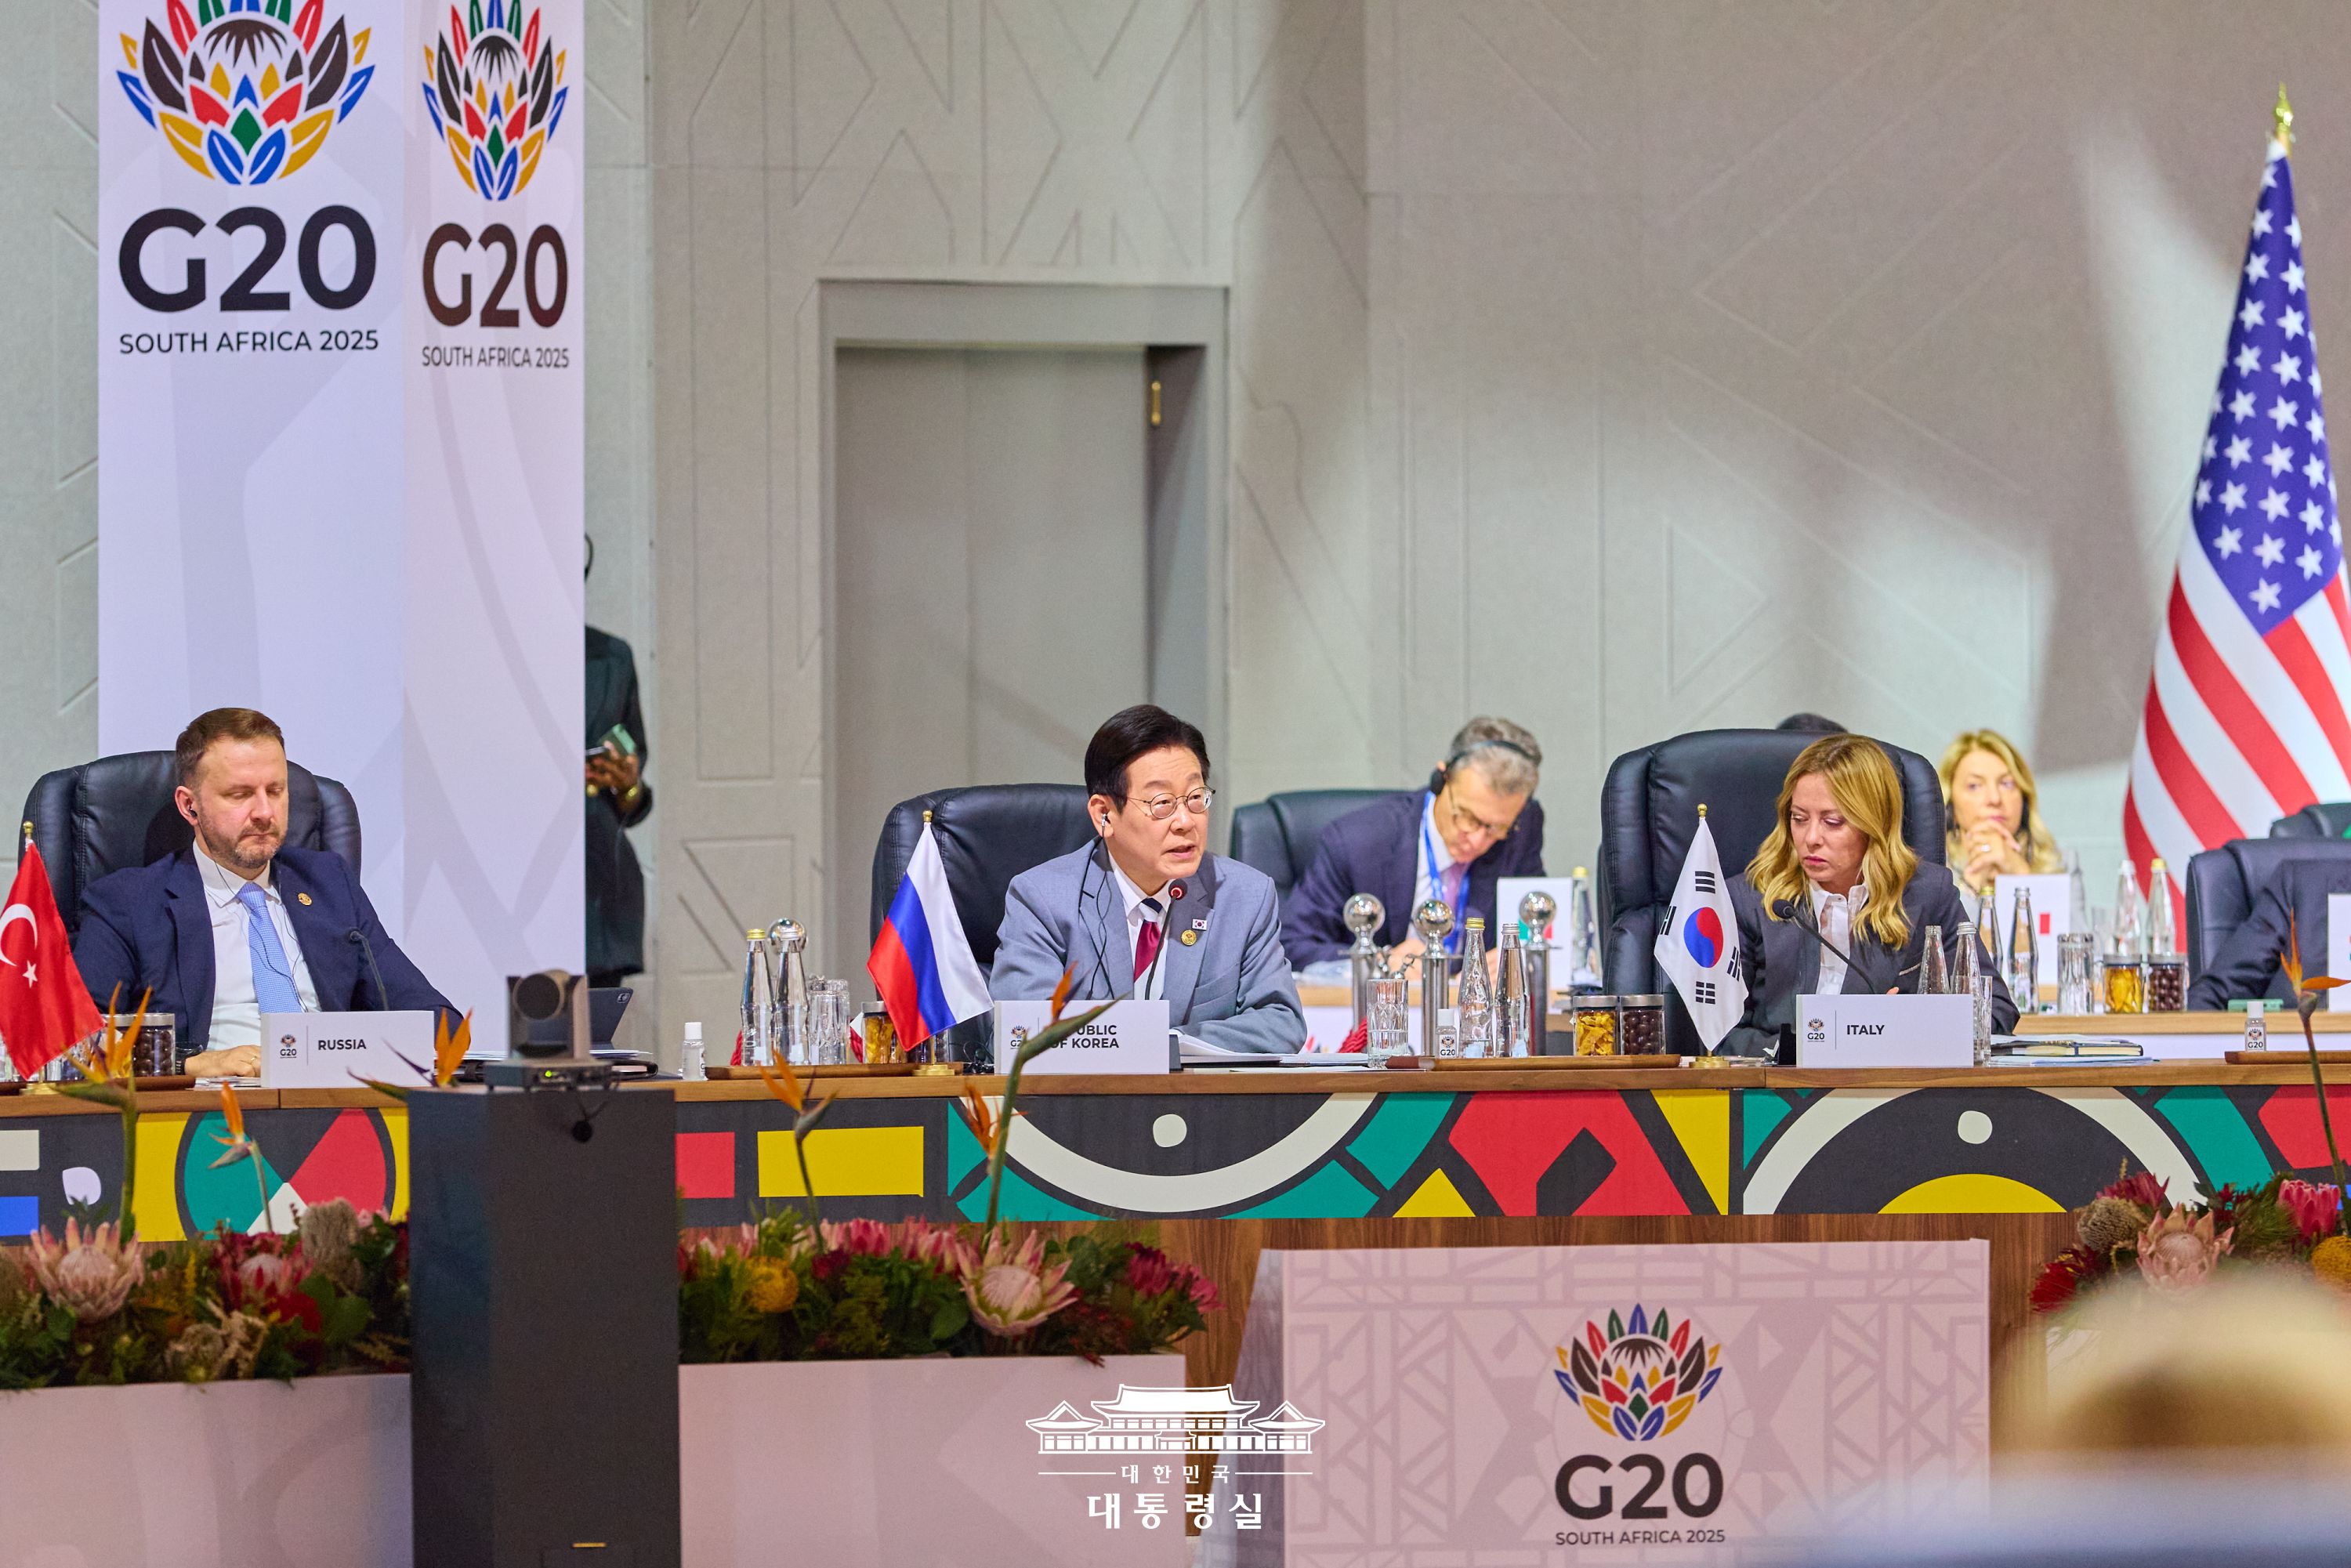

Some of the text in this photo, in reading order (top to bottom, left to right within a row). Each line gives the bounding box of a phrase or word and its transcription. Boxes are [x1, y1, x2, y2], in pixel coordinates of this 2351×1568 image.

[119, 205, 376, 312] G20
[422, 223, 568, 328] G20
[120, 330, 379, 354] SOUTH AFRICA 2025
[422, 346, 569, 368] SOUTH AFRICA 2025
[1077, 1025, 1117, 1035] UBLIC
[1846, 1024, 1885, 1035] ITALY
[318, 1039, 367, 1051] RUSSIA
[1072, 1038, 1119, 1048] KOREA
[1555, 1453, 1723, 1520] G20
[1556, 1530, 1725, 1545] SOUTH AFRICA 2025
